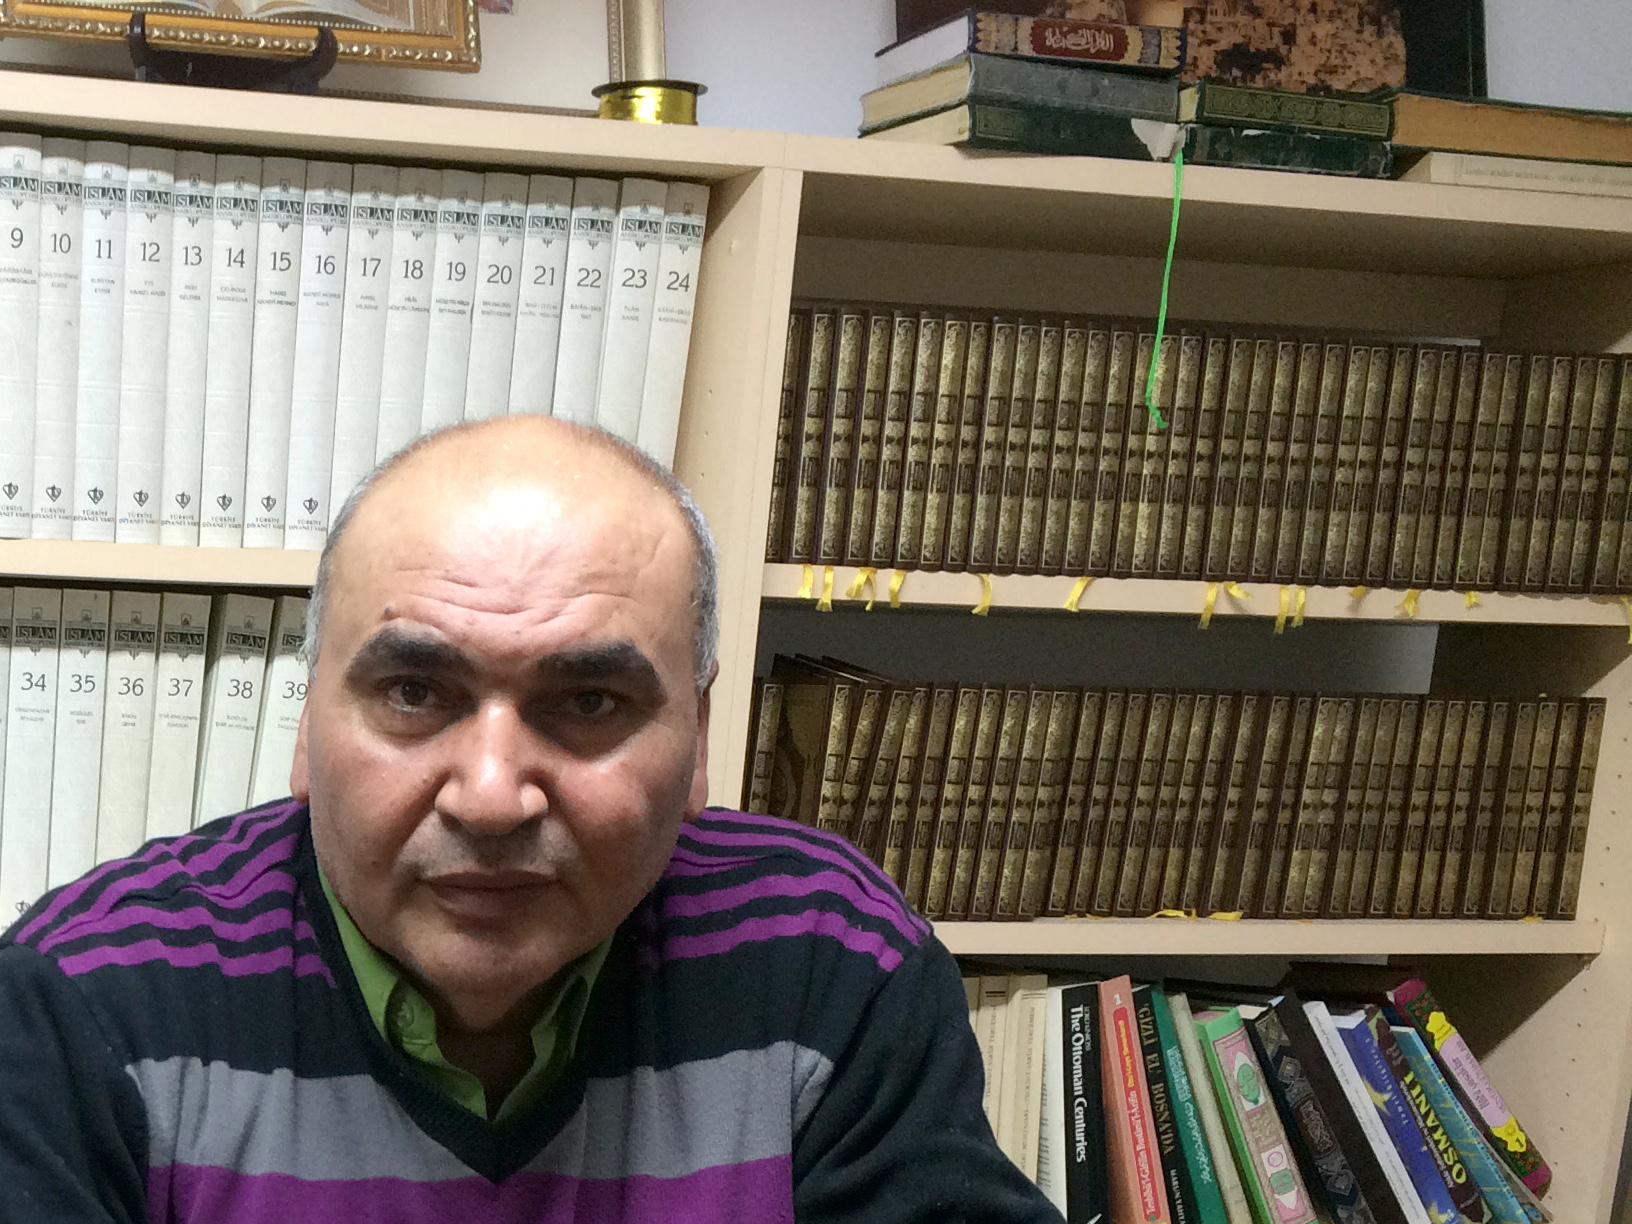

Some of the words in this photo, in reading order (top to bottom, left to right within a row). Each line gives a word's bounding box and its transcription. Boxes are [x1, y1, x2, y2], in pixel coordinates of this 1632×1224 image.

[11, 228, 23, 248] 9
[50, 233, 71, 254] 10
[95, 239, 112, 259] 11
[140, 242, 161, 262] 12
[183, 246, 202, 266] 13
[226, 248, 245, 268] 14
[270, 251, 292, 272] 15
[316, 254, 336, 275] 16
[361, 257, 381, 277] 17
[403, 259, 423, 279] 18
[447, 262, 466, 282] 19
[487, 264, 512, 285] 20
[533, 265, 555, 286] 21
[577, 267, 602, 288] 22
[622, 268, 647, 289] 23
[667, 271, 690, 292] 24
[21, 672, 46, 691] 34
[70, 674, 96, 693] 35
[118, 677, 144, 696] 36
[168, 678, 193, 697] 37
[227, 678, 253, 699] 38
[282, 681, 307, 701] 39
[1070, 1005, 1083, 1032] The
[1071, 1033, 1085, 1096] Ottoman
[1151, 1082, 1176, 1155] BOSNA'DA
[1403, 1071, 1467, 1184] OSMANLI
[1073, 1097, 1087, 1163] Centuries
[1170, 1169, 1183, 1198] HARUN
